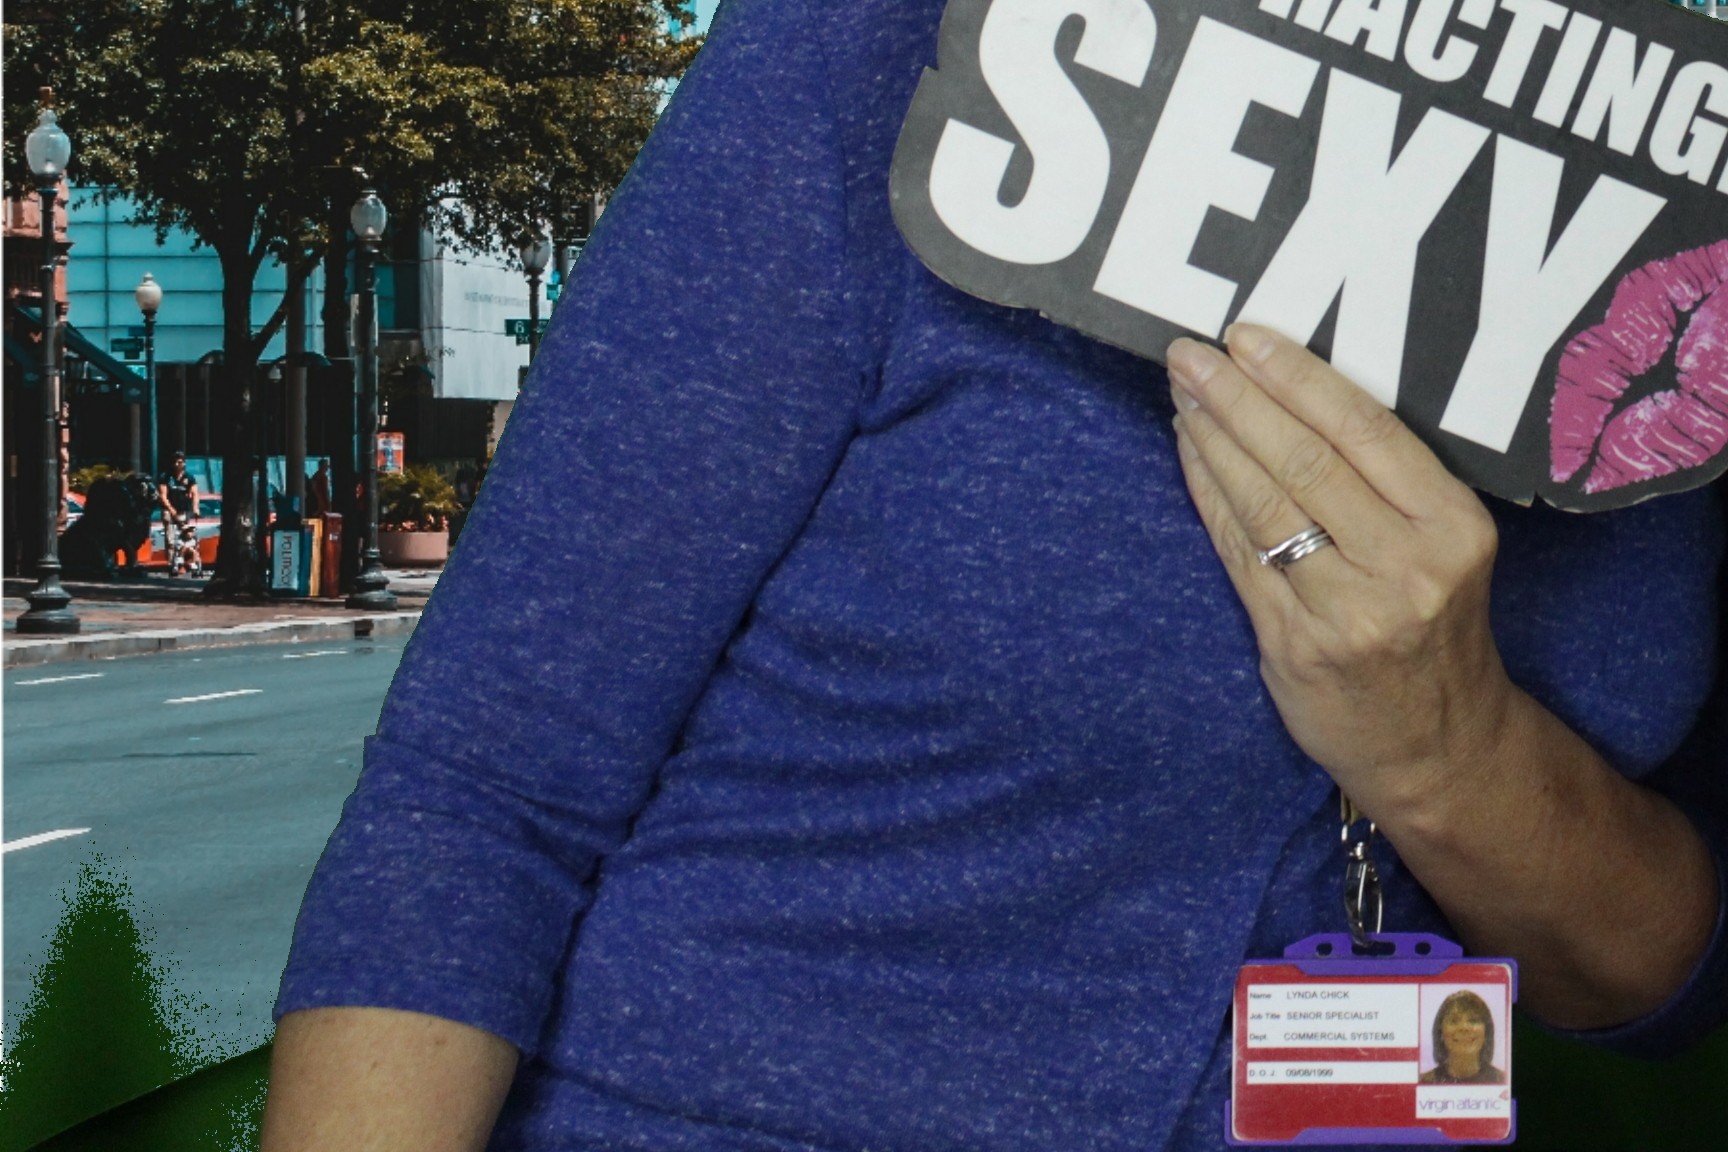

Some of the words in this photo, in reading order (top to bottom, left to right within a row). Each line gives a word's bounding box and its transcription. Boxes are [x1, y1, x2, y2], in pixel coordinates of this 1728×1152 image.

[1286, 991, 1318, 1000] LYNDA
[1320, 991, 1350, 1000] CHICK
[1286, 1011, 1322, 1020] SENIOR
[1325, 1011, 1380, 1020] SPECIALIST
[1283, 1032, 1348, 1041] COMMERCIAL
[1350, 1032, 1396, 1041] SYSTEMS
[1419, 1097, 1455, 1113] virgin
[1456, 1097, 1502, 1110] atlantic
